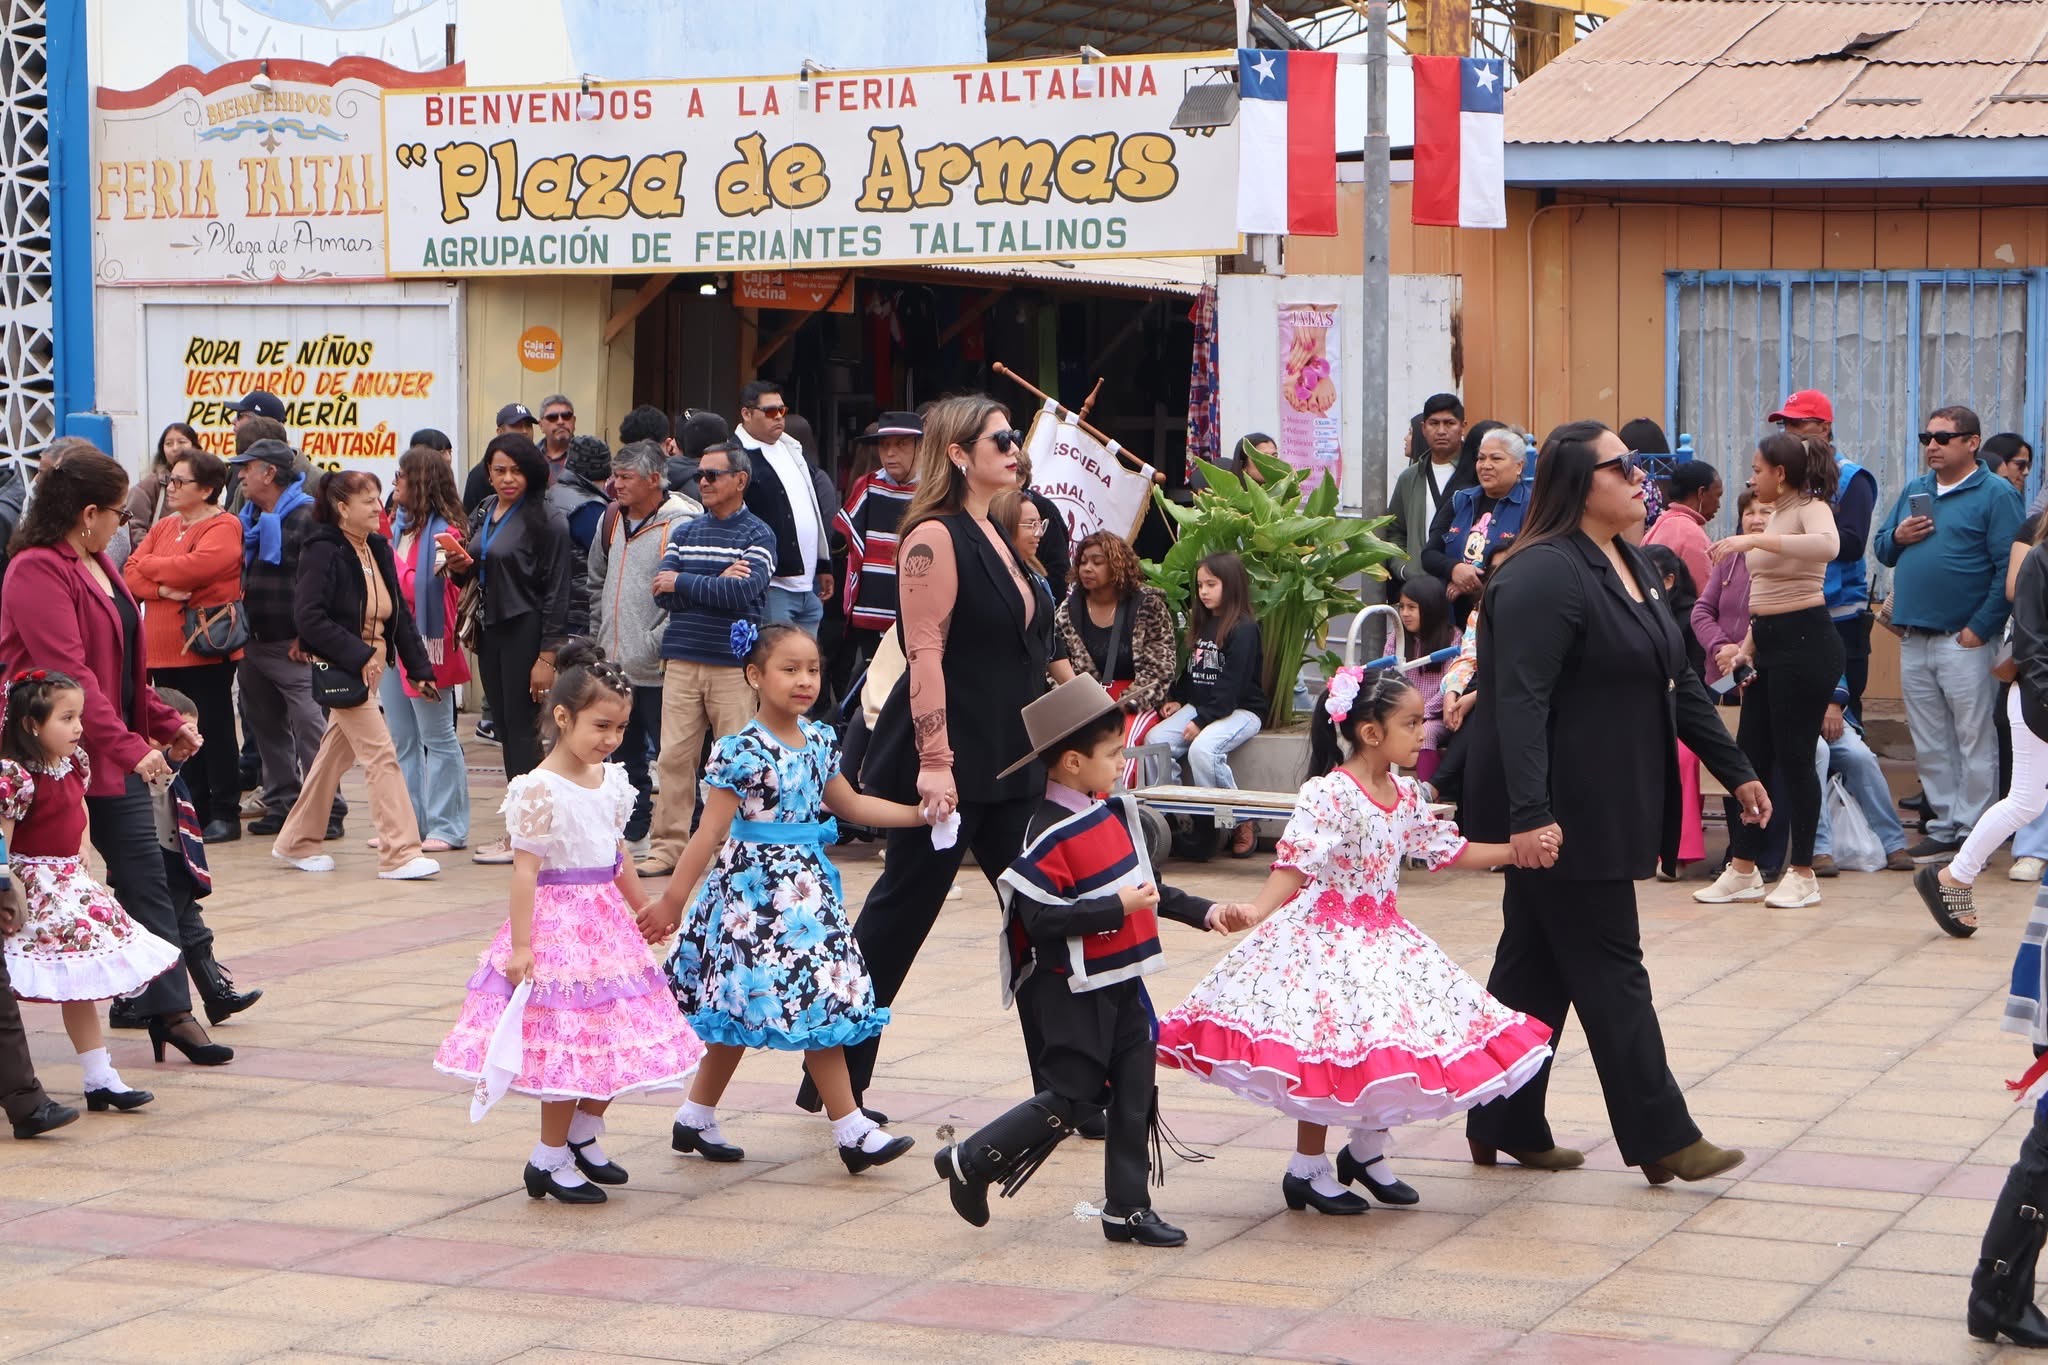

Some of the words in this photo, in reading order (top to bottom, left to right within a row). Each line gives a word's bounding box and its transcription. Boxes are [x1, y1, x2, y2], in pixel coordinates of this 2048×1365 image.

[205, 90, 333, 127] BIENVENIDOS
[425, 88, 652, 126] BIENVENIDOS
[687, 87, 704, 118] A
[738, 84, 780, 116] LA
[815, 76, 918, 113] FERIA
[953, 64, 1158, 105] TALTALINA
[96, 158, 220, 221] FERIA
[238, 153, 385, 218] TALTAL
[715, 130, 831, 218] de
[205, 221, 263, 271] Plaza
[267, 223, 289, 255] de
[289, 220, 375, 255] Armas
[423, 226, 609, 267] AGRUPACIÓN
[632, 232, 672, 263] DE
[695, 225, 882, 262] FERIANTES
[909, 217, 1127, 255] TALTALINOS
[743, 286, 787, 300] Vecina
[185, 336, 241, 366] ROPA
[256, 340, 289, 366] DE
[296, 333, 373, 366] NIÑOS
[524, 340, 545, 352] Caja
[524, 349, 556, 360] Vecina
[185, 366, 306, 396] VESTUARIO
[315, 370, 348, 396] DE
[352, 371, 434, 398] MUJER
[1030, 482, 1086, 503] RANAL
